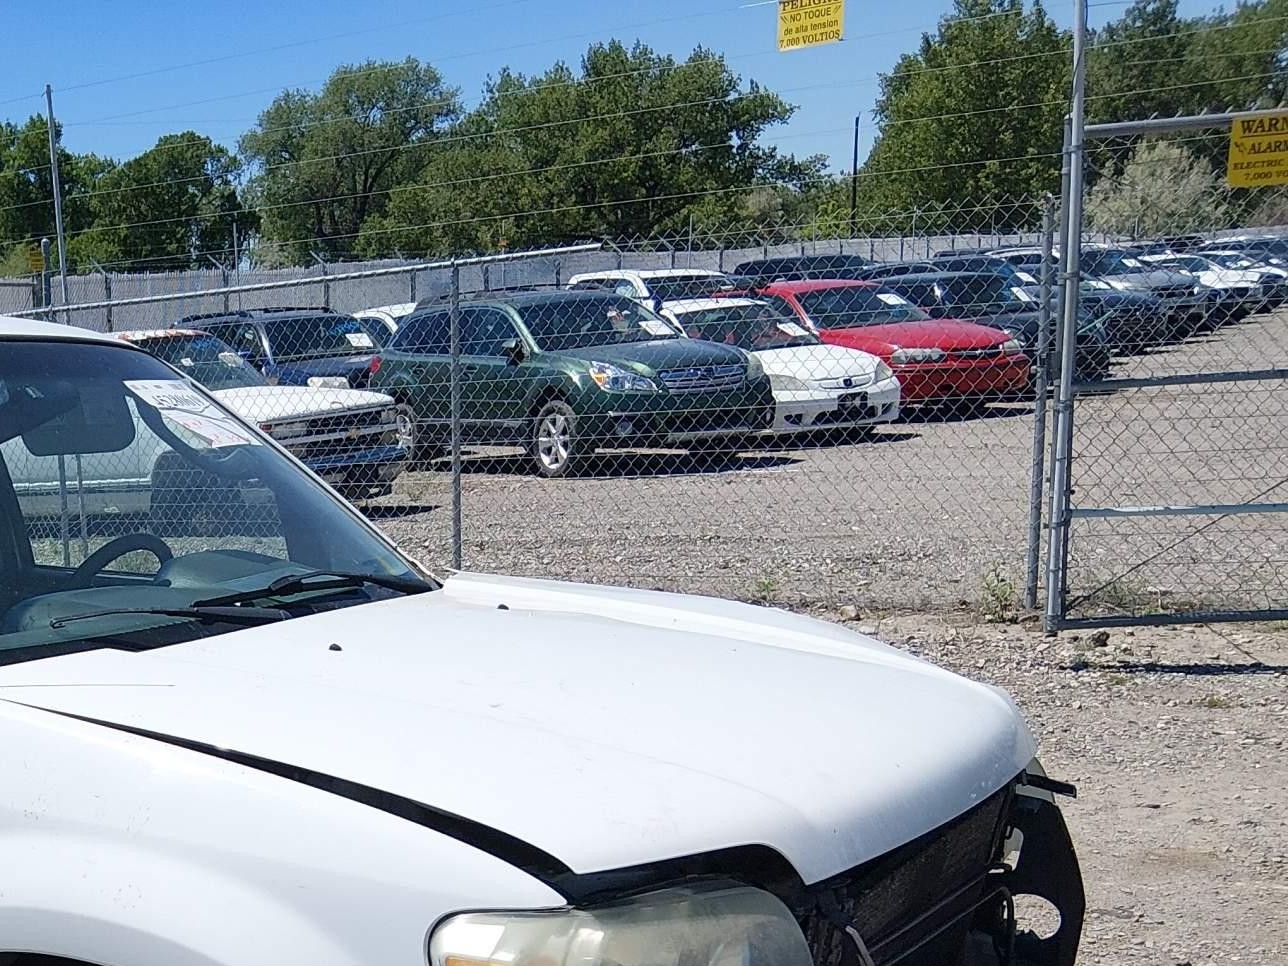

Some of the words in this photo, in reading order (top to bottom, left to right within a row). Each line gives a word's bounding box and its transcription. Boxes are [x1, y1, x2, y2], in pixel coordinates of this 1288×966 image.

[779, 0, 839, 11] PELIG
[789, 12, 802, 23] NO
[804, 7, 831, 19] TOQUE
[784, 27, 793, 36] de
[795, 25, 809, 34] alta
[802, 29, 841, 45] VOLTIOS
[1233, 158, 1285, 171] ELECTRIC
